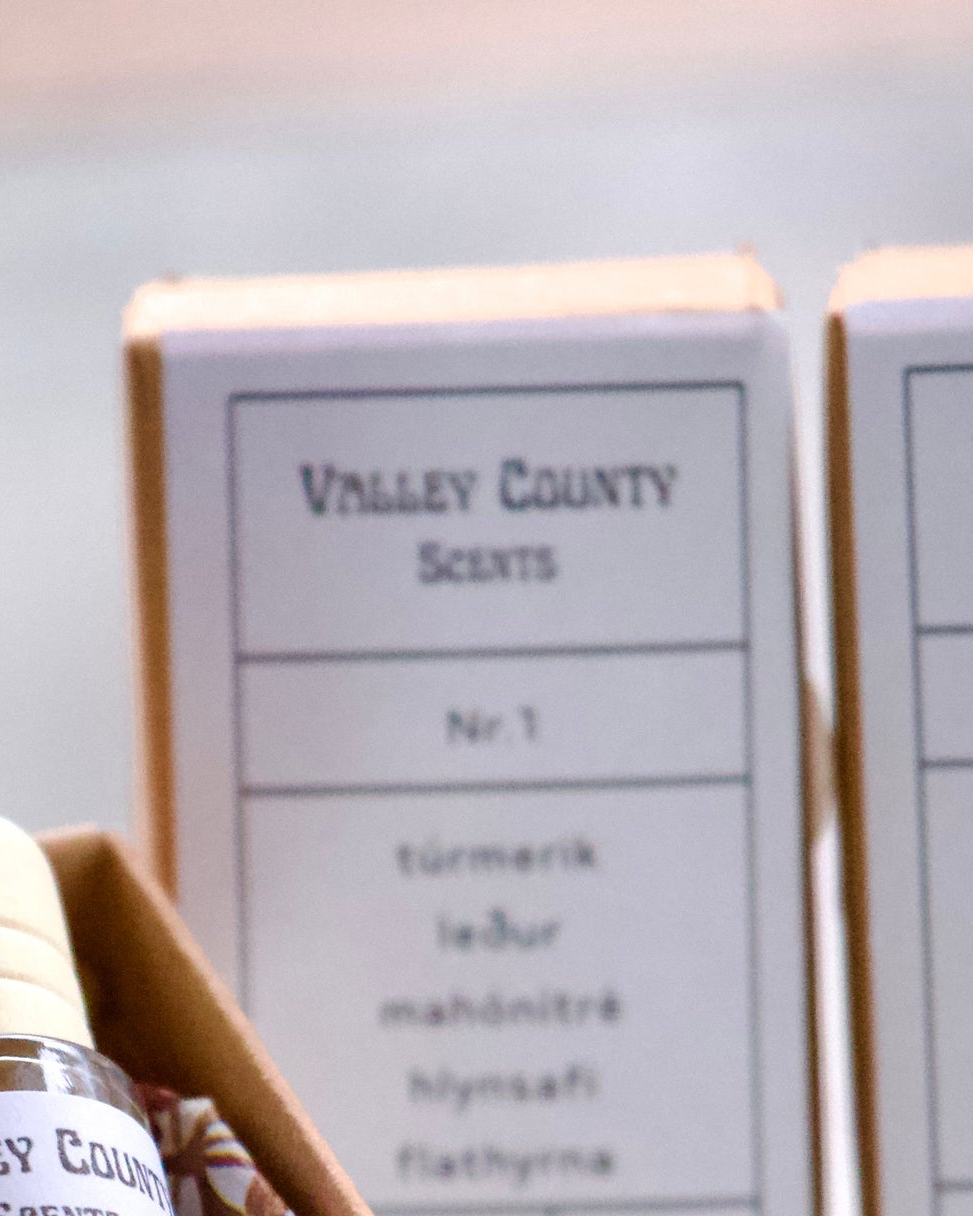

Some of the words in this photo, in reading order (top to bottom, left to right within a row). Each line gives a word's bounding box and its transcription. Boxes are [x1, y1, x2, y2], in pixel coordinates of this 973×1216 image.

[300, 462, 477, 515] VALLEY
[500, 457, 678, 512] COUNTY
[417, 541, 557, 584] SCENTS
[446, 705, 538, 746] Nr.1
